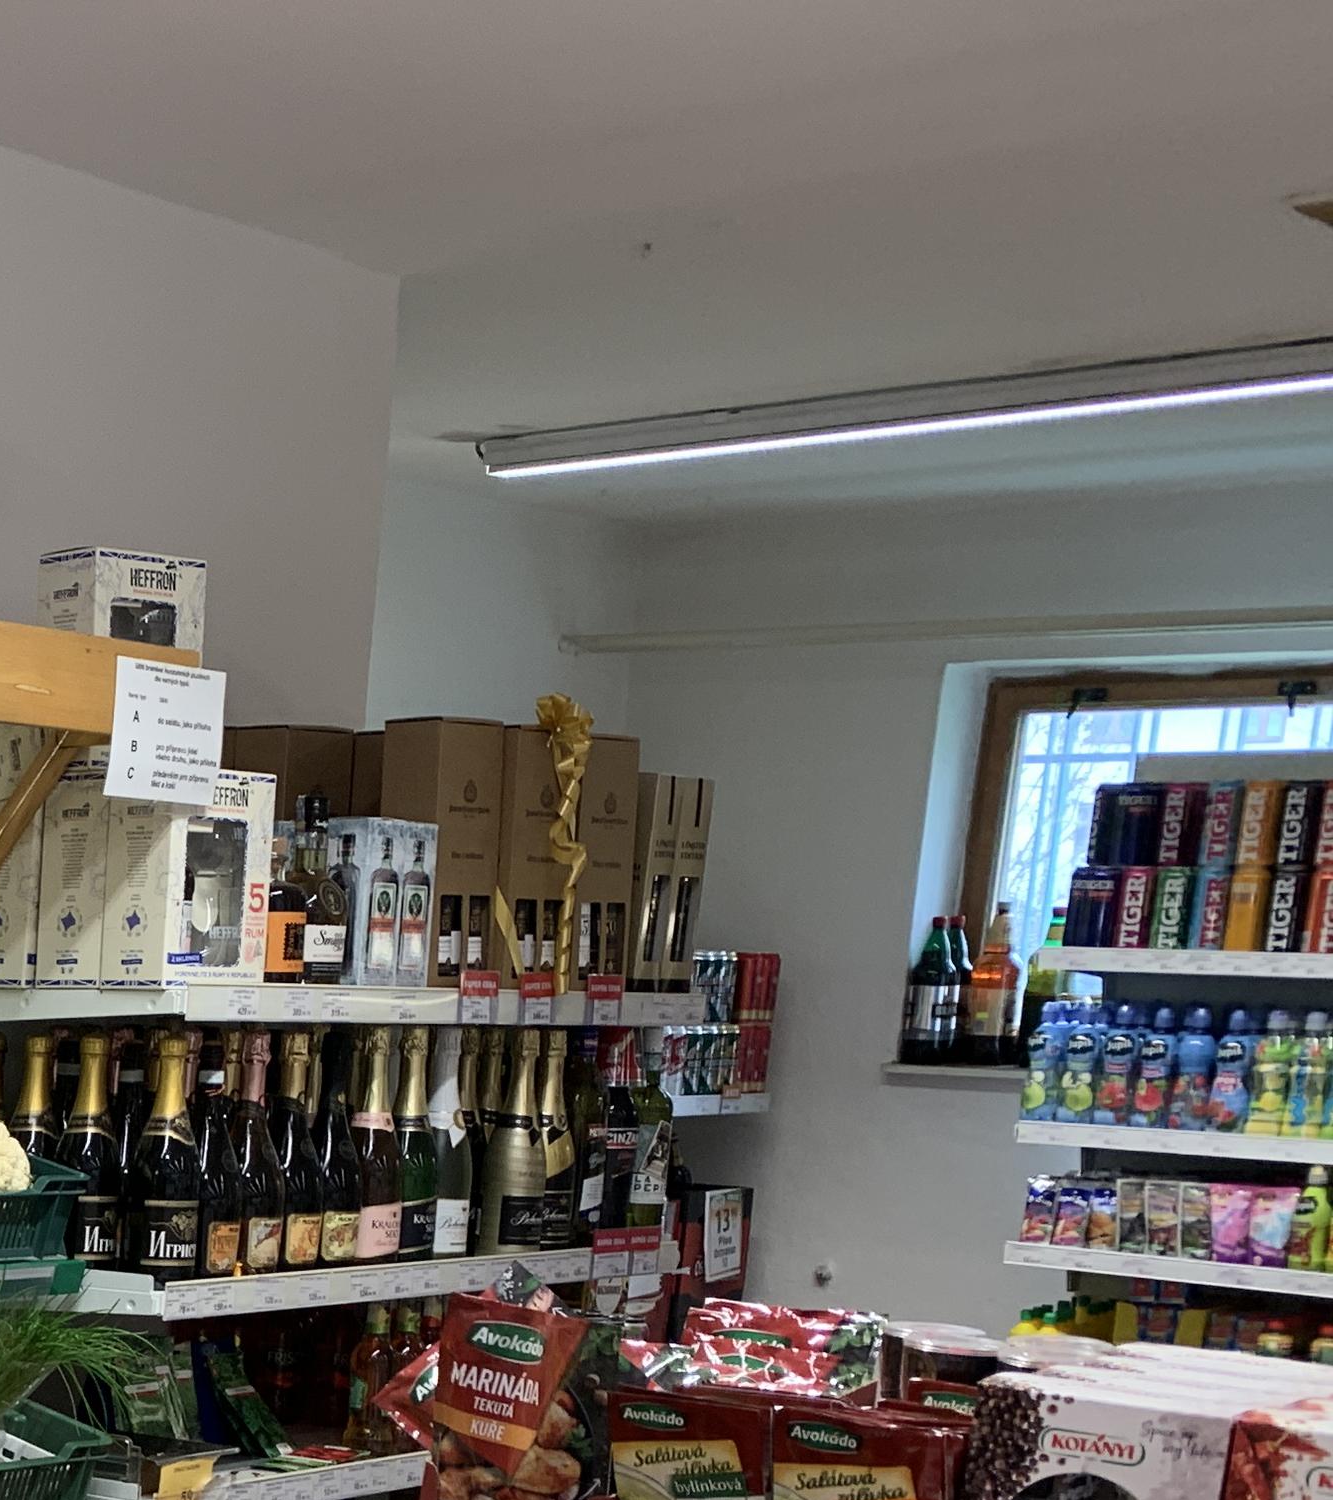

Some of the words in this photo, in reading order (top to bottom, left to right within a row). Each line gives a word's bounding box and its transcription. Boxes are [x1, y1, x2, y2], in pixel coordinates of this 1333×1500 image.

[130, 568, 176, 591] HEFFRON
[133, 710, 140, 723] A
[131, 740, 137, 752] B
[127, 767, 135, 779] C
[213, 786, 249, 808] EFFRON
[1159, 789, 1186, 863] TIGER
[1280, 787, 1309, 863] TIGER
[248, 882, 266, 913] 5
[1119, 874, 1146, 947] TIGER
[1158, 877, 1187, 949] TIGER
[1268, 874, 1297, 952] TIGER
[244, 927, 265, 939] RUM
[451, 1361, 540, 1406] MARINÁDA
[474, 1396, 515, 1419] TEKUTÁ
[623, 1407, 684, 1427] Avokádo
[470, 1419, 505, 1441] KUŘE
[790, 1425, 858, 1450] Avokádo
[634, 1444, 707, 1468] Salátová
[1051, 1432, 1136, 1462] KOTÁNYI
[674, 1478, 744, 1495] bylinková
[795, 1469, 878, 1492] Salátová
